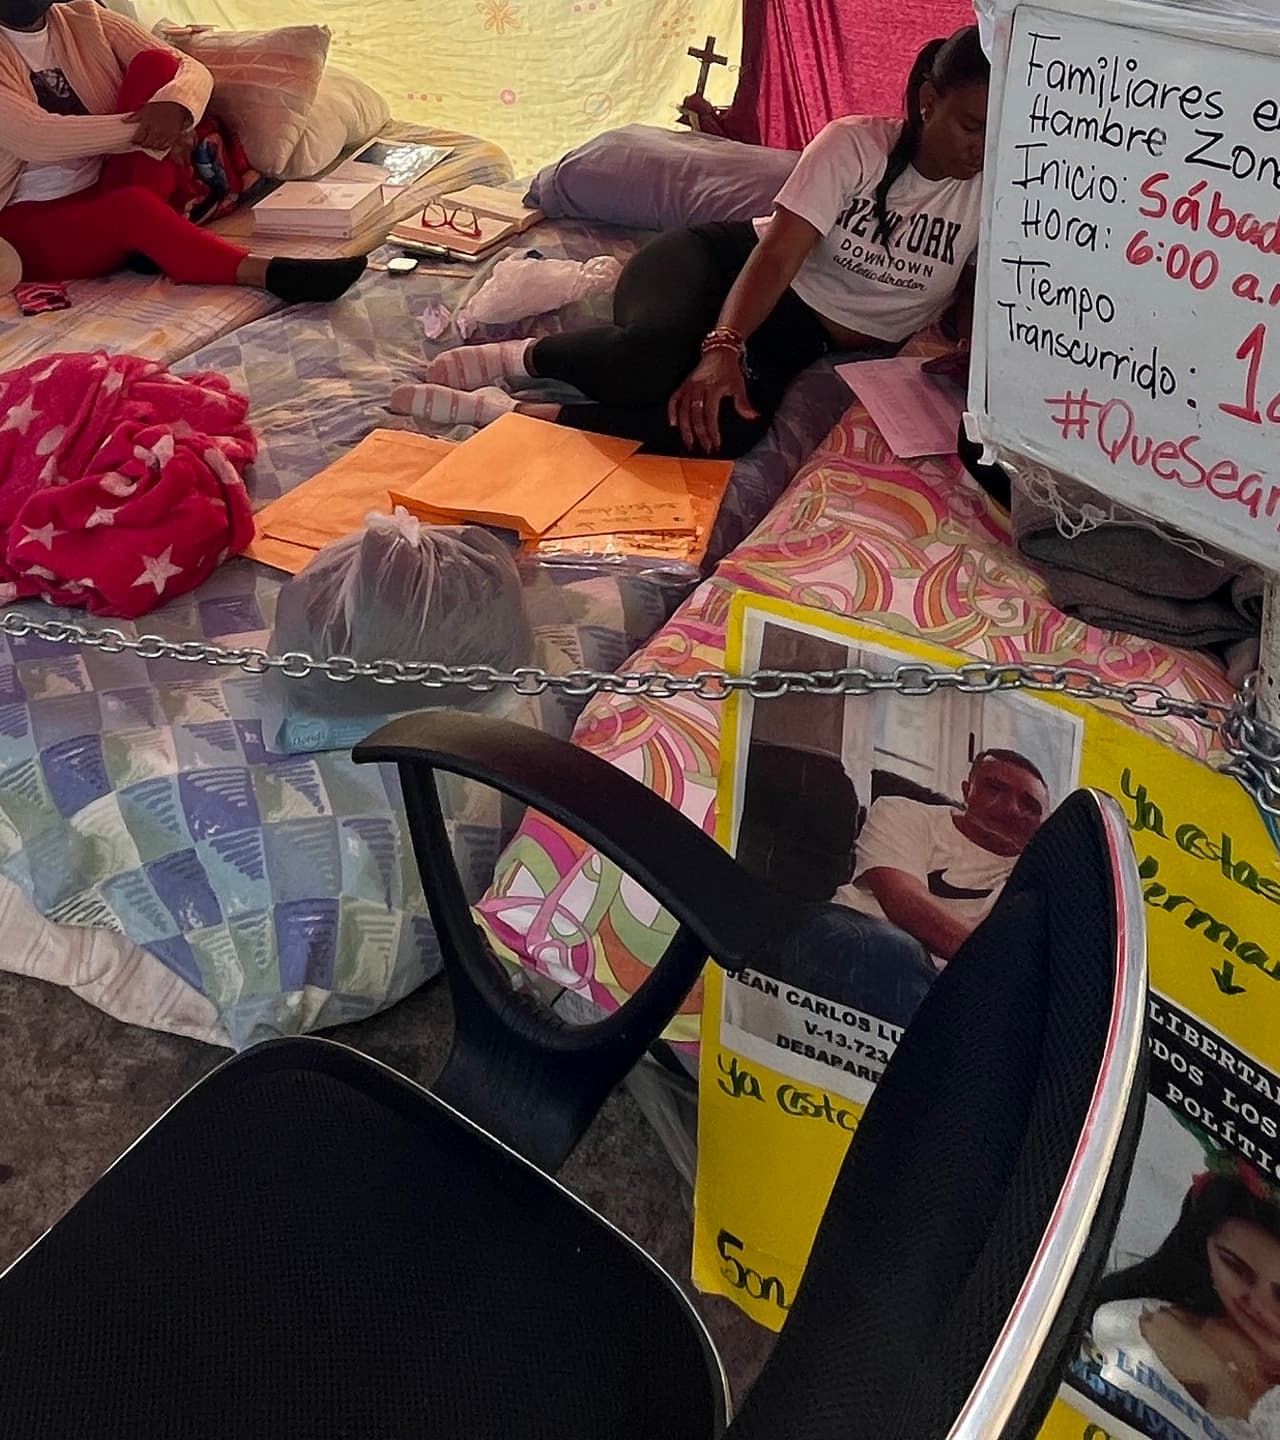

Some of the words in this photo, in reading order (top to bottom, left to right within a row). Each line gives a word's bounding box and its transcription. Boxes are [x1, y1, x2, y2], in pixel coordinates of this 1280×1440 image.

[1027, 32, 1225, 122] Familiares
[1029, 94, 1168, 156] Hambre
[1011, 141, 1129, 205] Inicio:
[841, 238, 934, 278] DOWNTOWN
[1020, 200, 1112, 254] Hora:
[1125, 236, 1219, 291] 6:00
[1001, 255, 1116, 325] Tiempo
[726, 969, 779, 999] JEAN
[786, 990, 872, 1033] CARLOS
[1148, 1036, 1204, 1087] DOS
[1222, 1087, 1278, 1138] LOS
